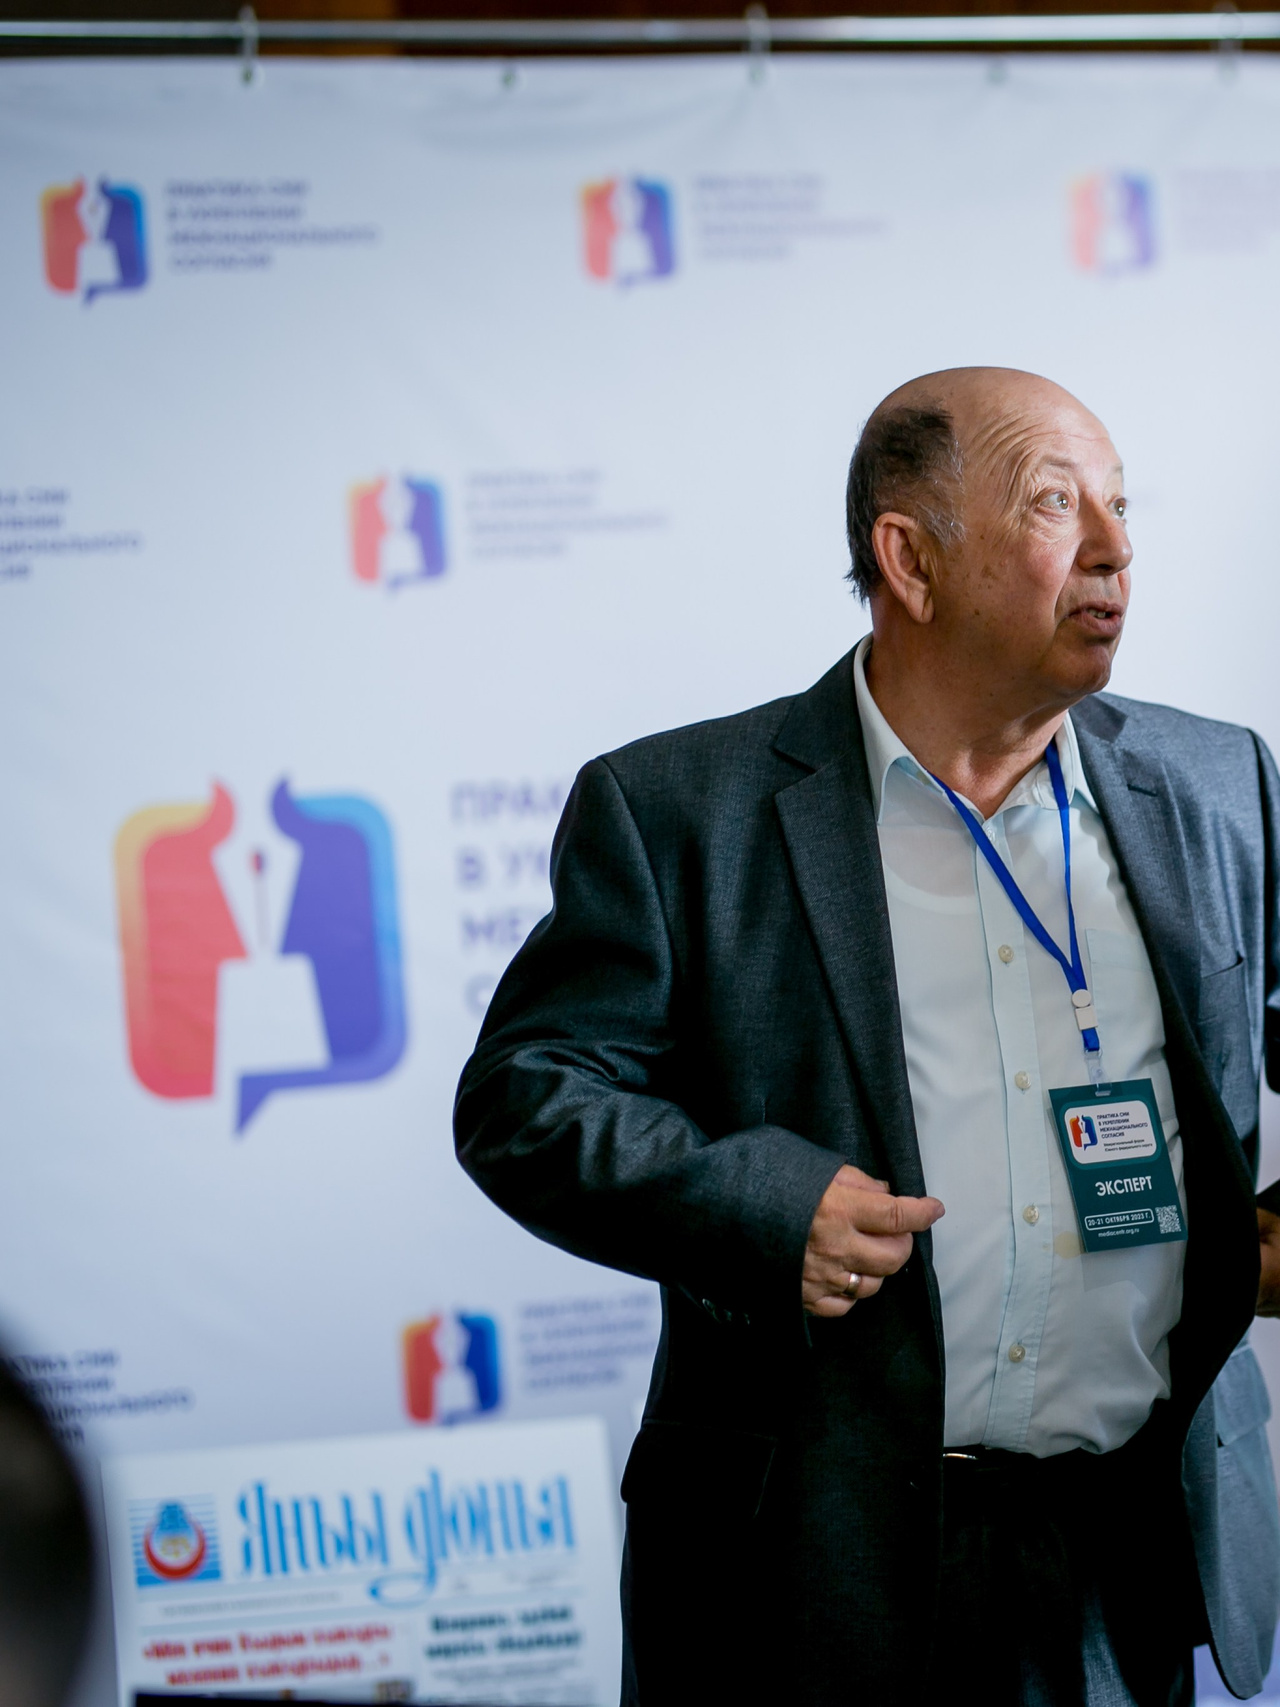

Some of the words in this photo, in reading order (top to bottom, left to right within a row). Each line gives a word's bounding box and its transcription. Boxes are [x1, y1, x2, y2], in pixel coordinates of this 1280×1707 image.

[1100, 1122, 1149, 1132] МЕЖНАЦИОНАЛЬНОГО
[1102, 1118, 1130, 1126] УКРЕПЛЕНИИ
[1101, 1131, 1125, 1139] СОГЛАСИЯ
[1095, 1175, 1153, 1196] ЭКСПЕРТ
[1088, 1218, 1104, 1226] 20-21
[1105, 1214, 1130, 1224] ОКТЯБРЯ
[1131, 1213, 1145, 1221] 2023
